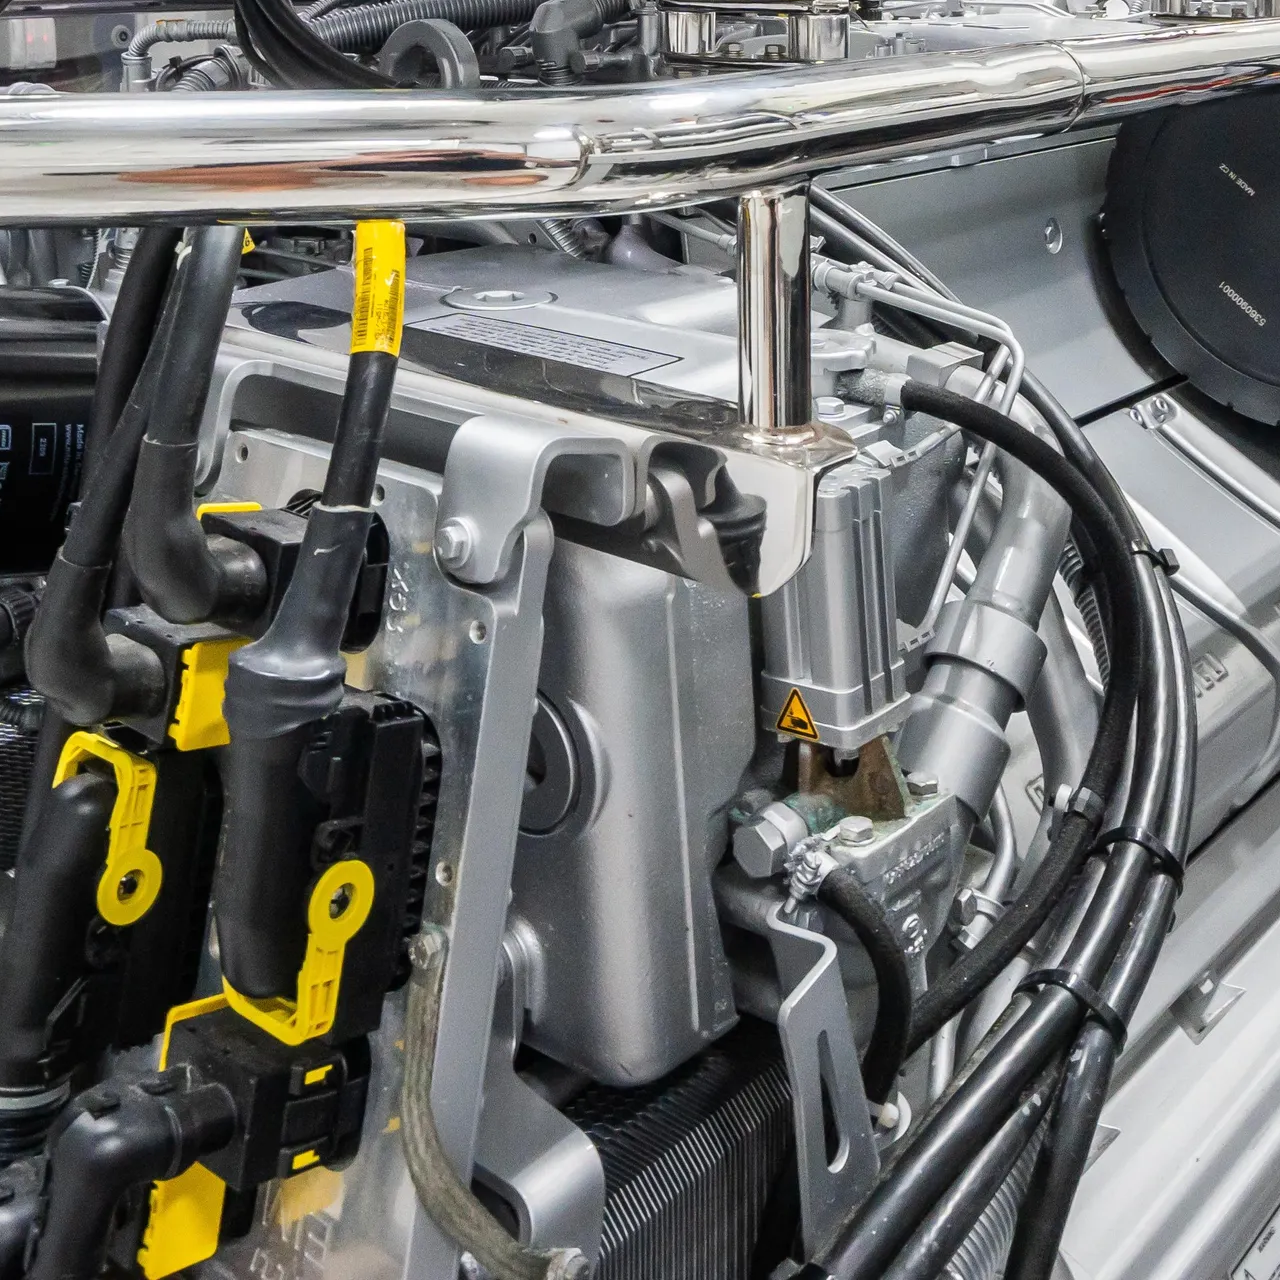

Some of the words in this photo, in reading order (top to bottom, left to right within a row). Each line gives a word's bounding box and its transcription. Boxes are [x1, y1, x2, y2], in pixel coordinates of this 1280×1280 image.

[1219, 162, 1230, 174] CZ
[1228, 170, 1237, 180] IN
[1236, 177, 1256, 197] MADE
[1218, 280, 1267, 328] 5360900001
[1193, 652, 1230, 698] tu
